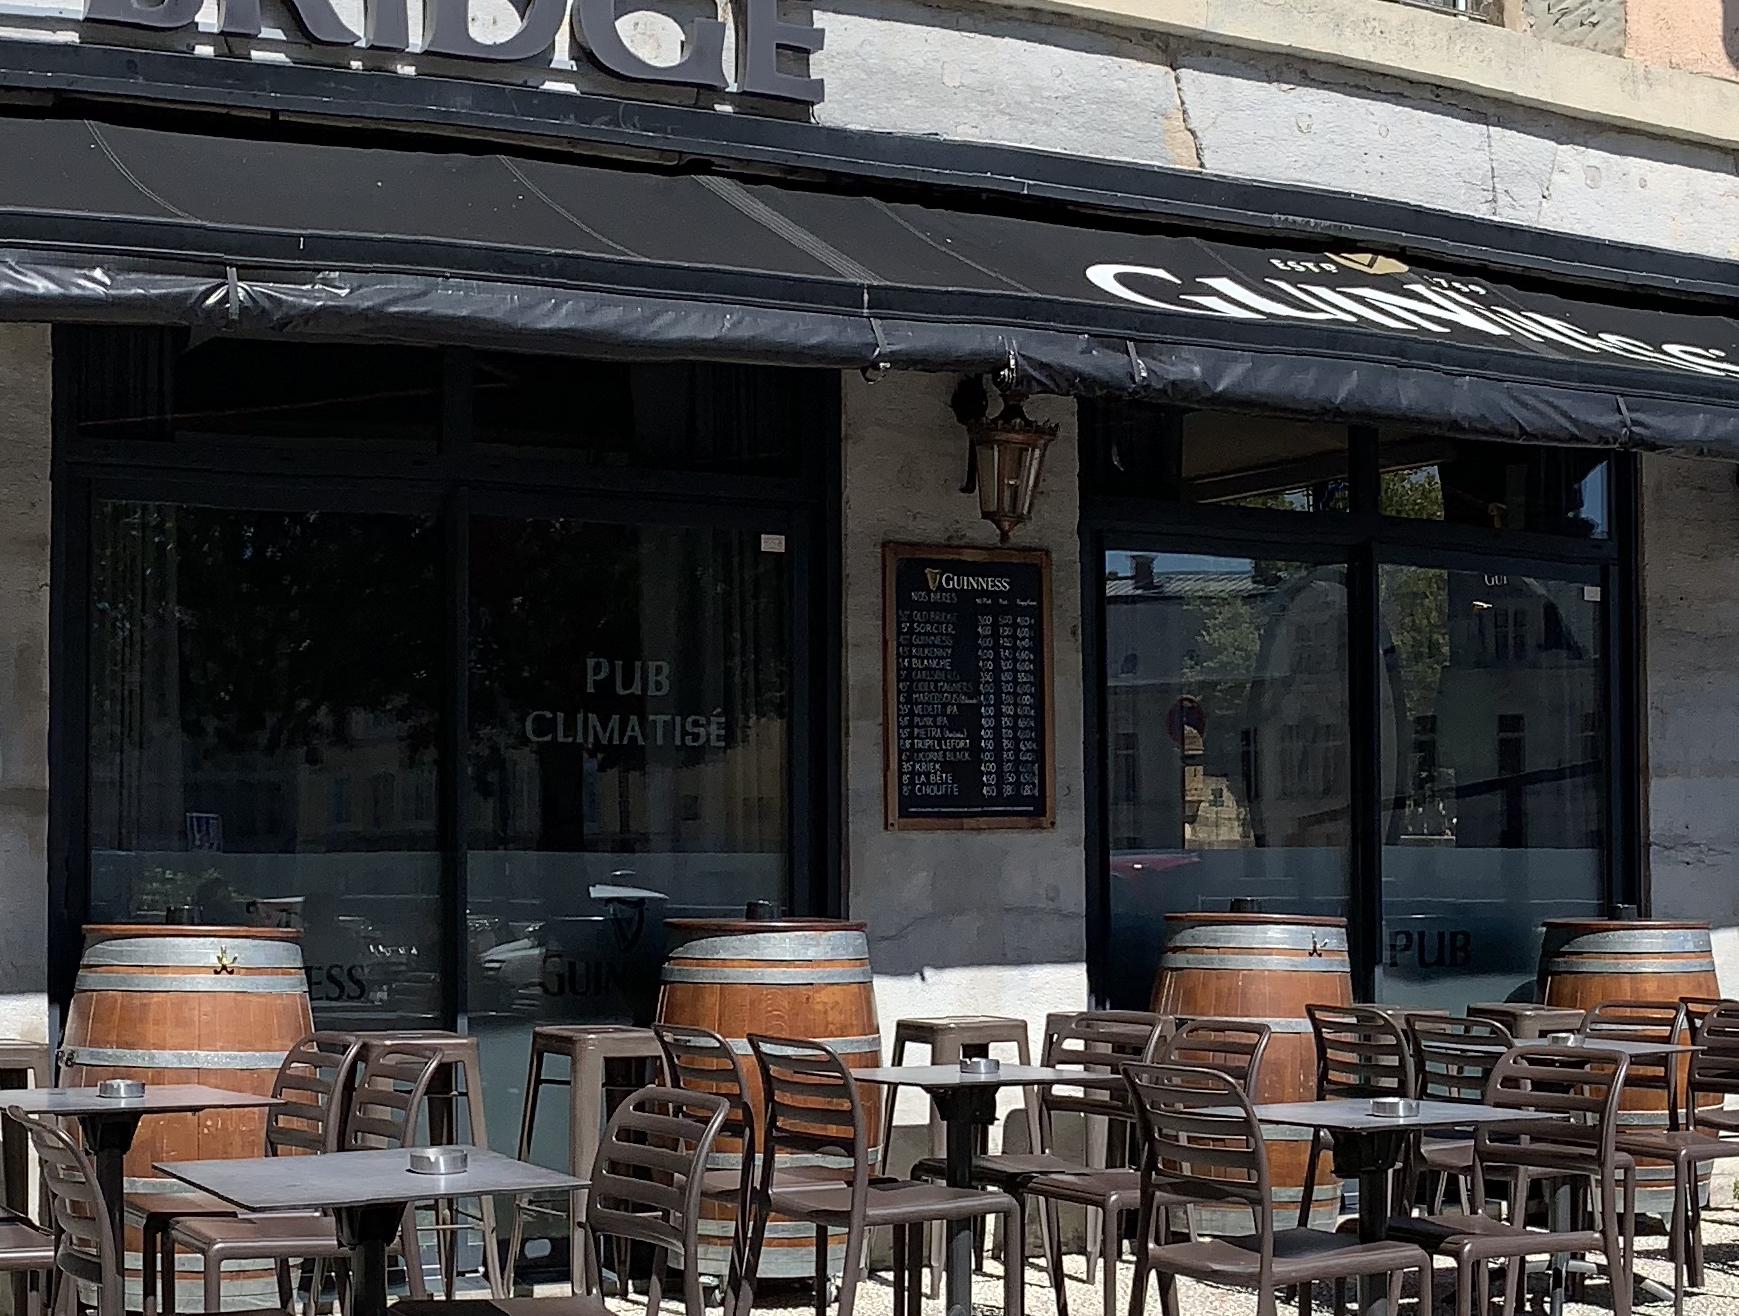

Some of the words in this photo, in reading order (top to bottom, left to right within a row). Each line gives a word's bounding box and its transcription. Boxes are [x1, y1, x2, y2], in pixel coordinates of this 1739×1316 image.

[942, 572, 1011, 591] GUINNESS
[913, 622, 956, 634] SORCIER
[912, 658, 952, 669] BLANCHE
[584, 657, 671, 697] PUB
[524, 707, 727, 748] CLIMATISÉ
[913, 727, 942, 738] PIETRA
[914, 739, 940, 749] TRIPEL
[941, 739, 970, 749] LEFORT
[914, 761, 942, 772] KRIEK
[915, 774, 927, 784] LA
[929, 771, 953, 783] BÊTE
[914, 784, 959, 796] CHOUFFE
[1388, 929, 1473, 968] PUB
